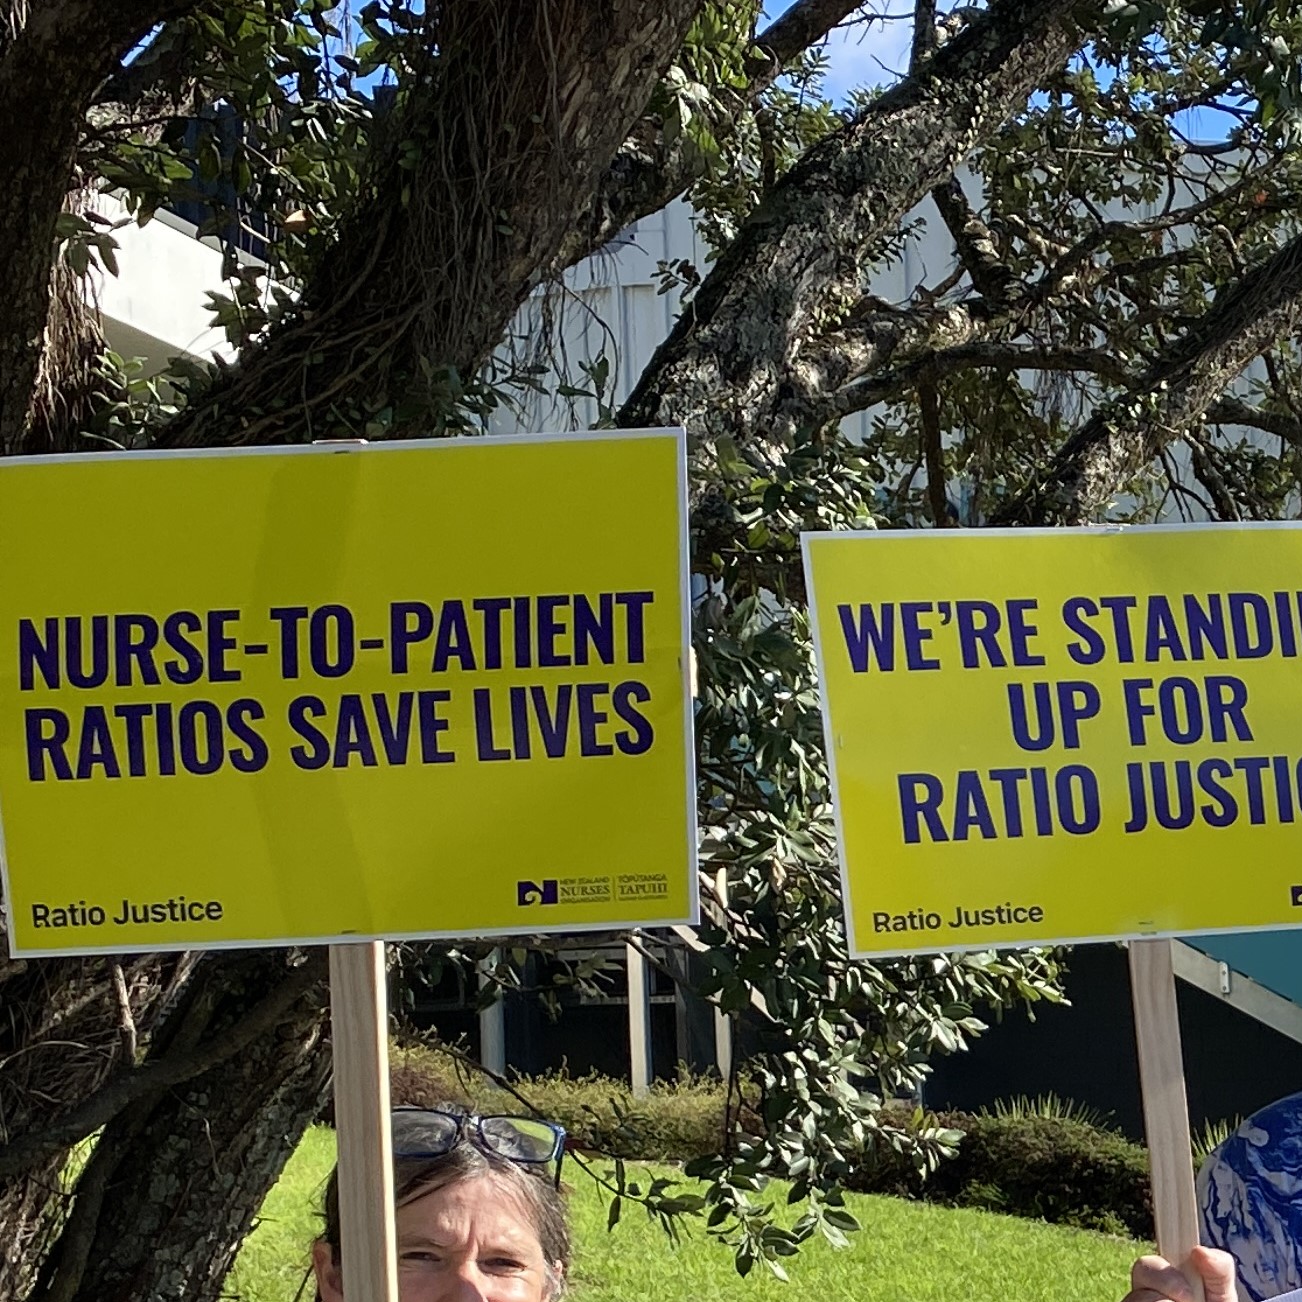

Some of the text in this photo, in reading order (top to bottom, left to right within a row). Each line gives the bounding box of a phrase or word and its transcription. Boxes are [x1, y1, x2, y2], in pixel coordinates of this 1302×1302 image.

[19, 590, 654, 691] NURSE-TO-PATIENT
[838, 599, 1046, 673] WE'RE
[25, 681, 654, 782] RATIOS SAVE LIVES
[1007, 675, 1254, 752] UP FOR
[897, 764, 1100, 844] RATIO
[33, 897, 224, 929] Ratio Justice
[873, 902, 1044, 933] Ratio Justice
